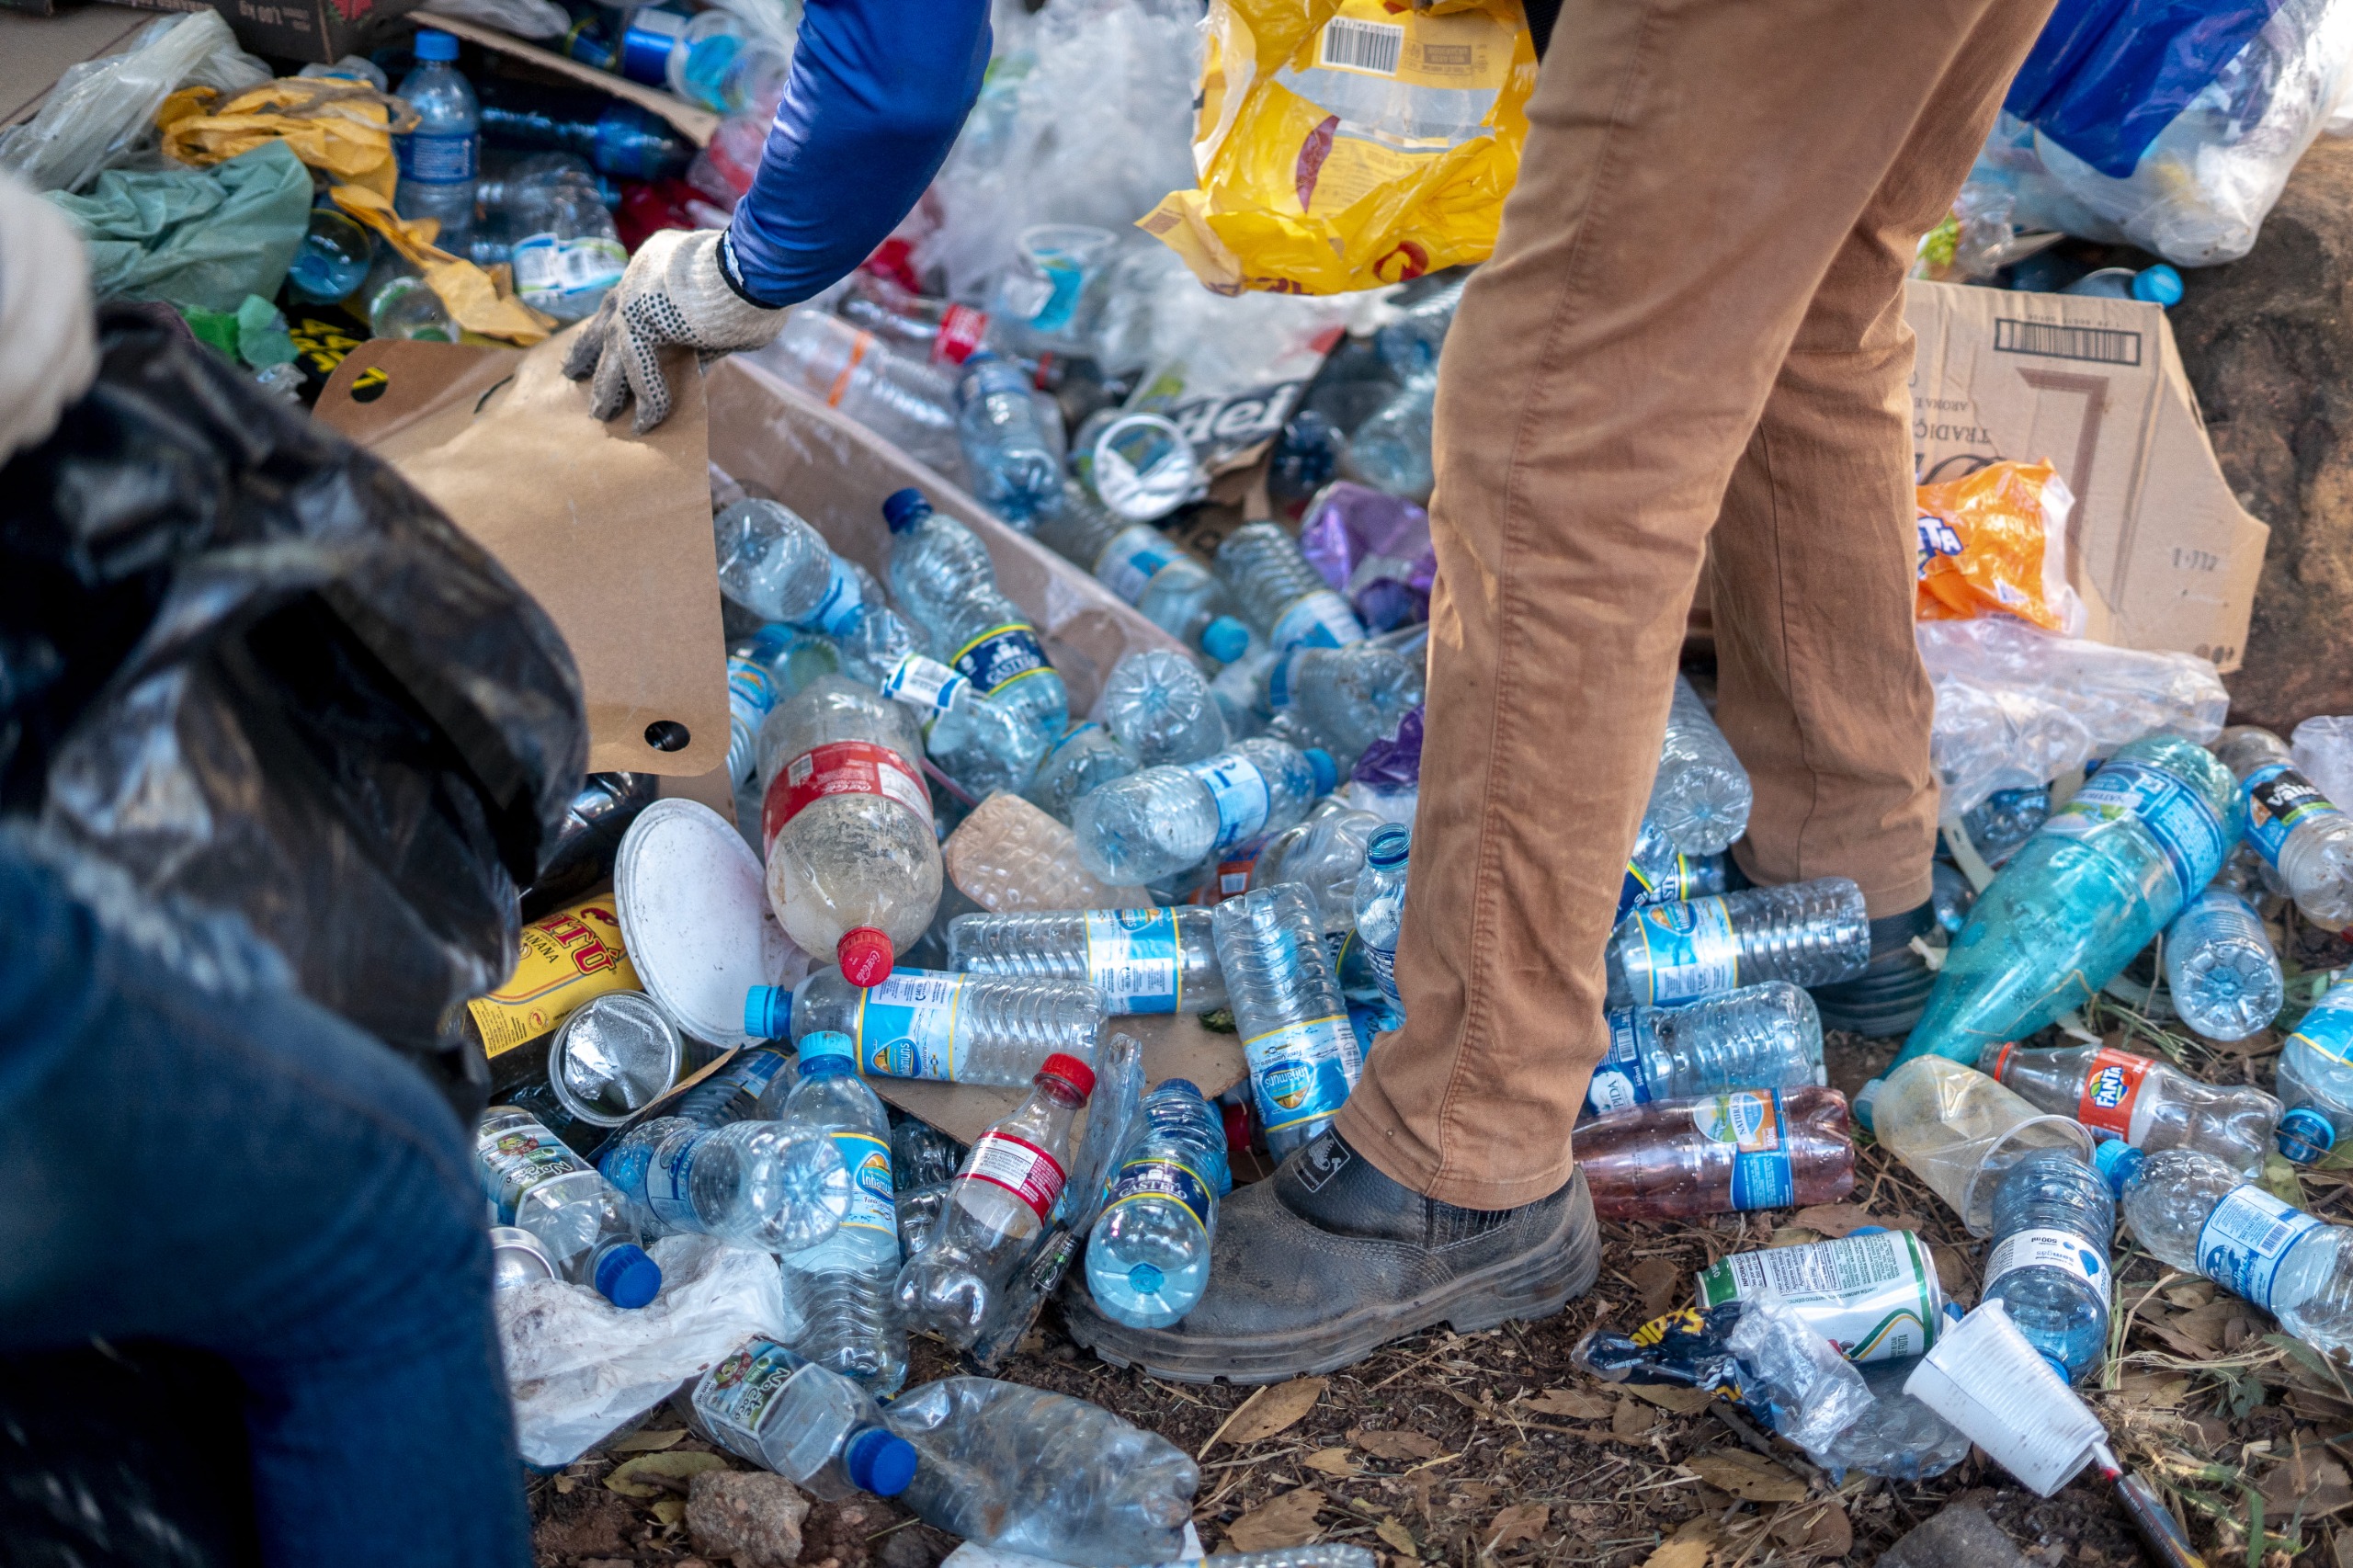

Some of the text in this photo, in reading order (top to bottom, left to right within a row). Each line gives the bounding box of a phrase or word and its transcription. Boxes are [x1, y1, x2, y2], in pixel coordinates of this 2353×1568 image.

[1926, 398, 1967, 410] AROMA
[1913, 418, 1991, 445] TRADIÇ
[1264, 1066, 1310, 1087] Inhamuns
[2096, 1066, 2121, 1107] FANTA
[1608, 1079, 1623, 1107] PIDA
[1119, 1181, 1187, 1199] CASTELO
[733, 1387, 758, 1421] Coco
[743, 1367, 790, 1418] Norte
